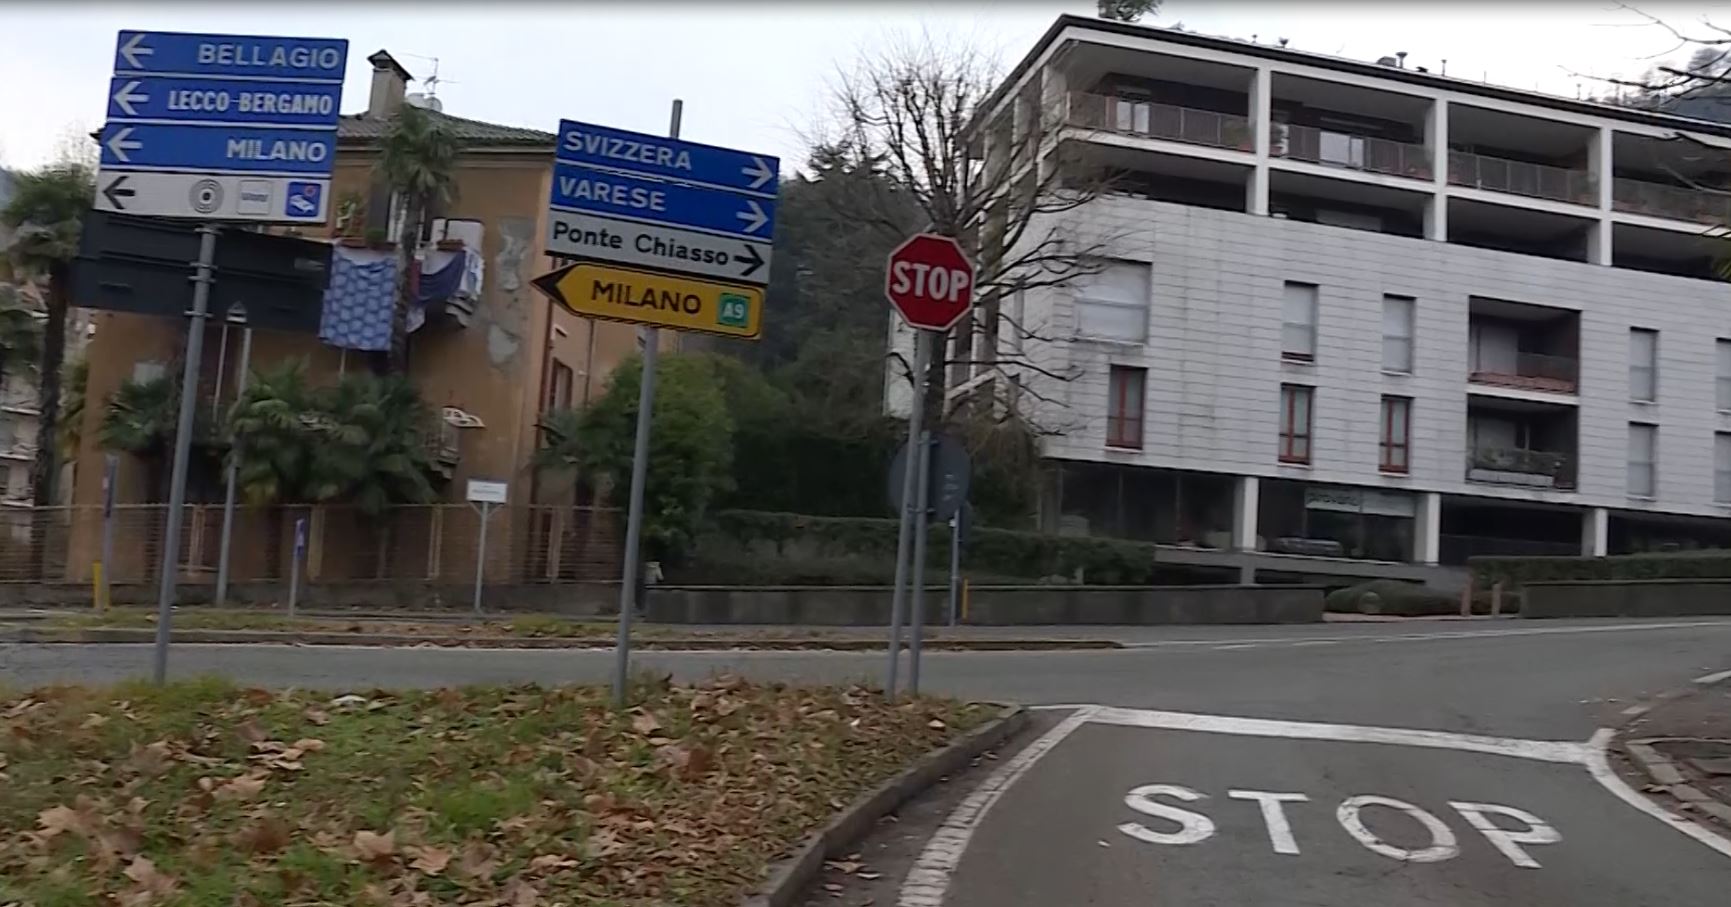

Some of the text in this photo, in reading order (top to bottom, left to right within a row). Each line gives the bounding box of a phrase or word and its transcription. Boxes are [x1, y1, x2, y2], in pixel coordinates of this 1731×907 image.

[199, 43, 340, 69] BELLAGIO
[226, 138, 327, 162] MILANO
[563, 130, 692, 171] SVIZZERA
[559, 175, 667, 211] VARESE
[553, 221, 729, 266] Ponte Chiasso
[591, 280, 745, 320] MILANO A9
[892, 261, 969, 302] STOP
[1117, 783, 1563, 869] STOP
